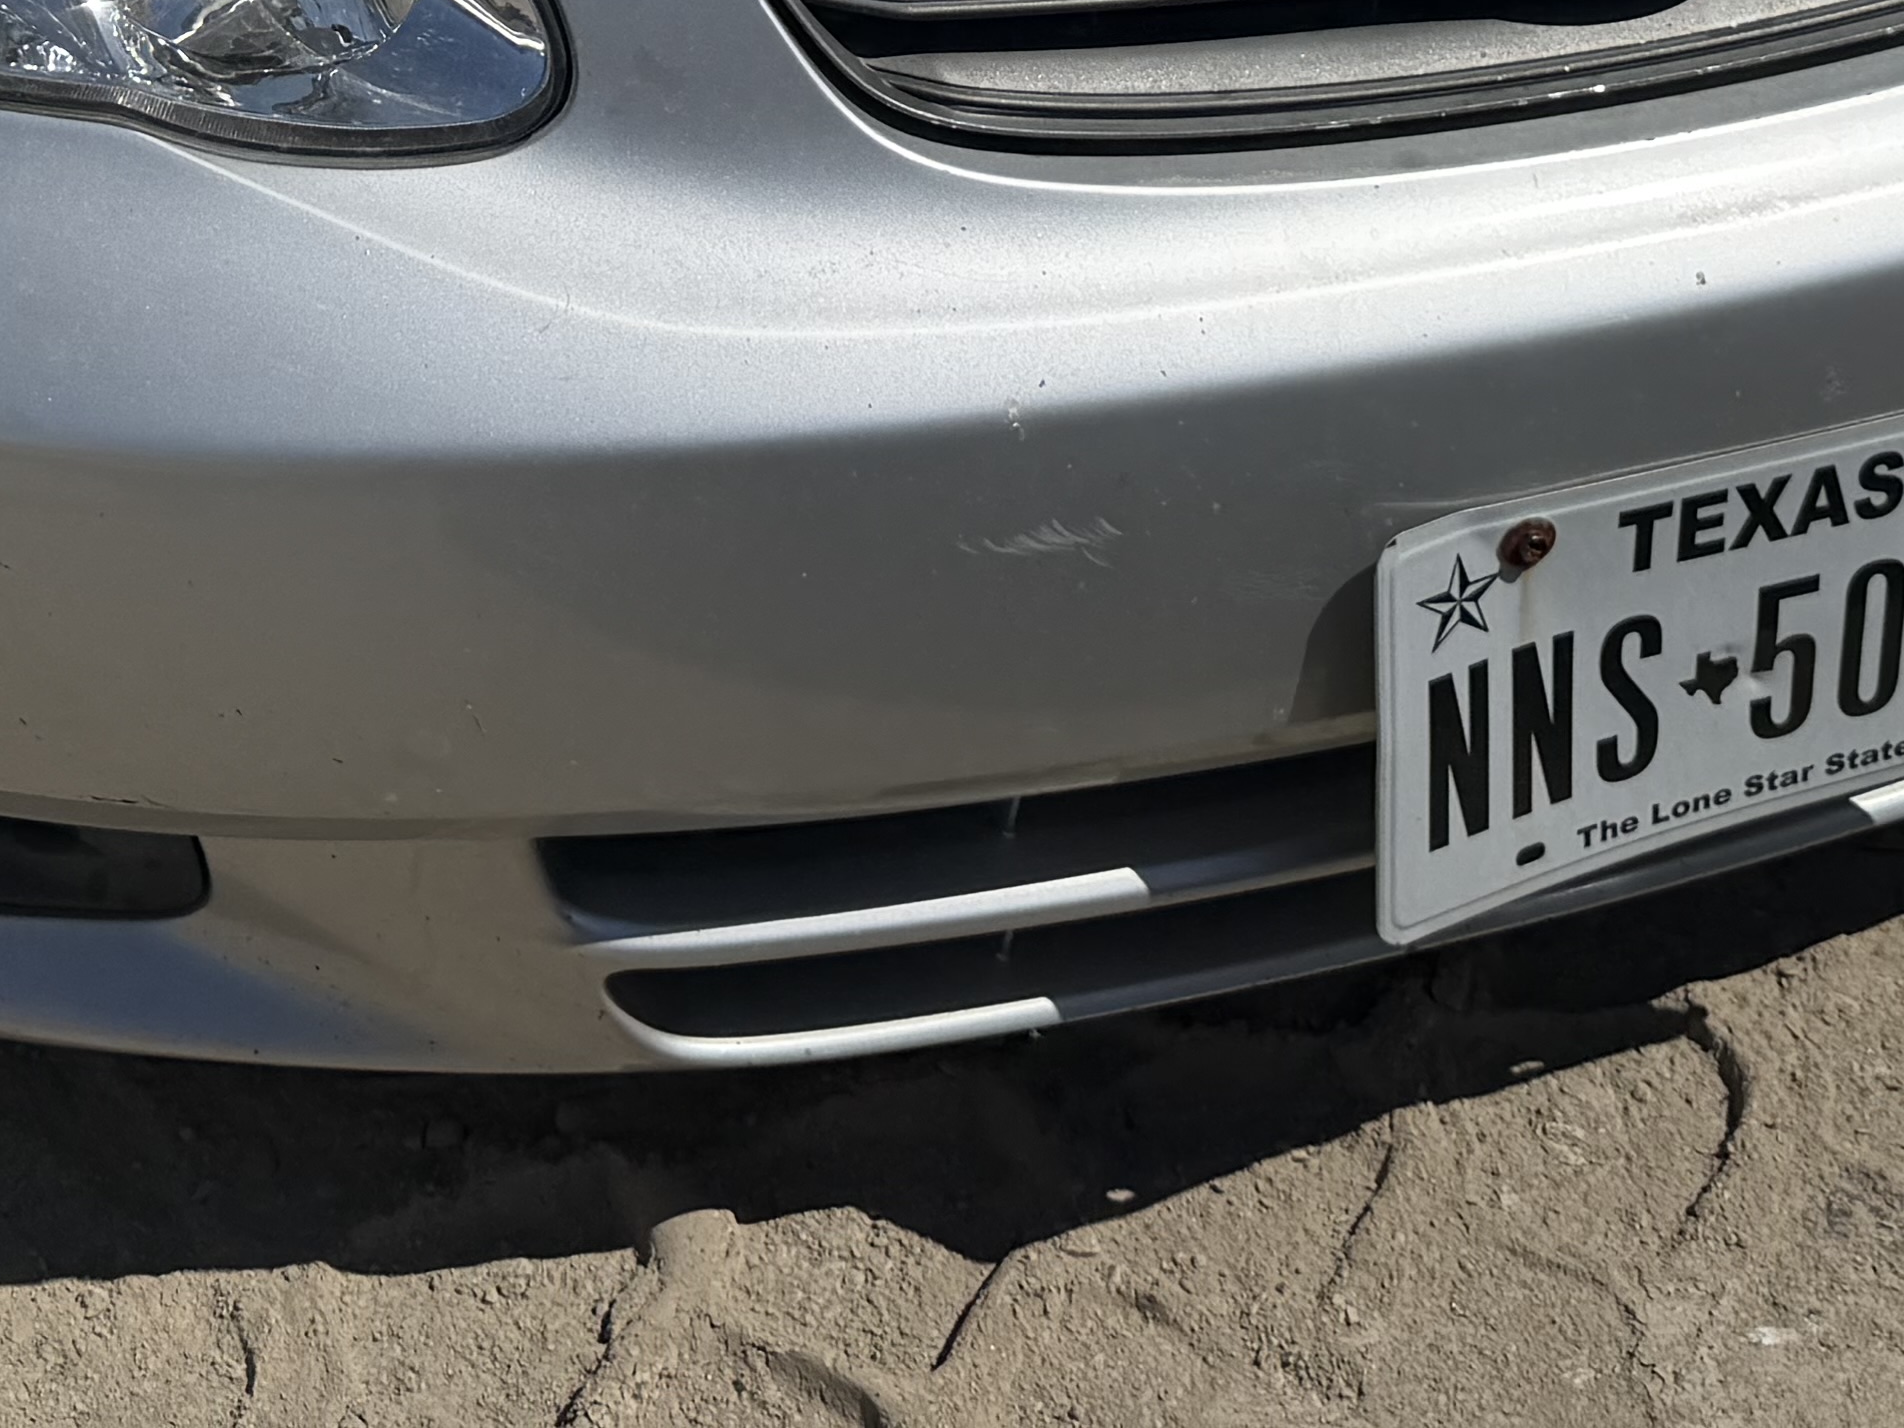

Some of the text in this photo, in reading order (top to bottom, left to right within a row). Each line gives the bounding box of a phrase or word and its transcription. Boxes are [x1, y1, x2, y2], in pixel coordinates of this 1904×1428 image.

[1427, 613, 1663, 853] NNS
[1576, 814, 1640, 850] The
[1650, 787, 1733, 826] Lone
[1743, 763, 1816, 798] Star
